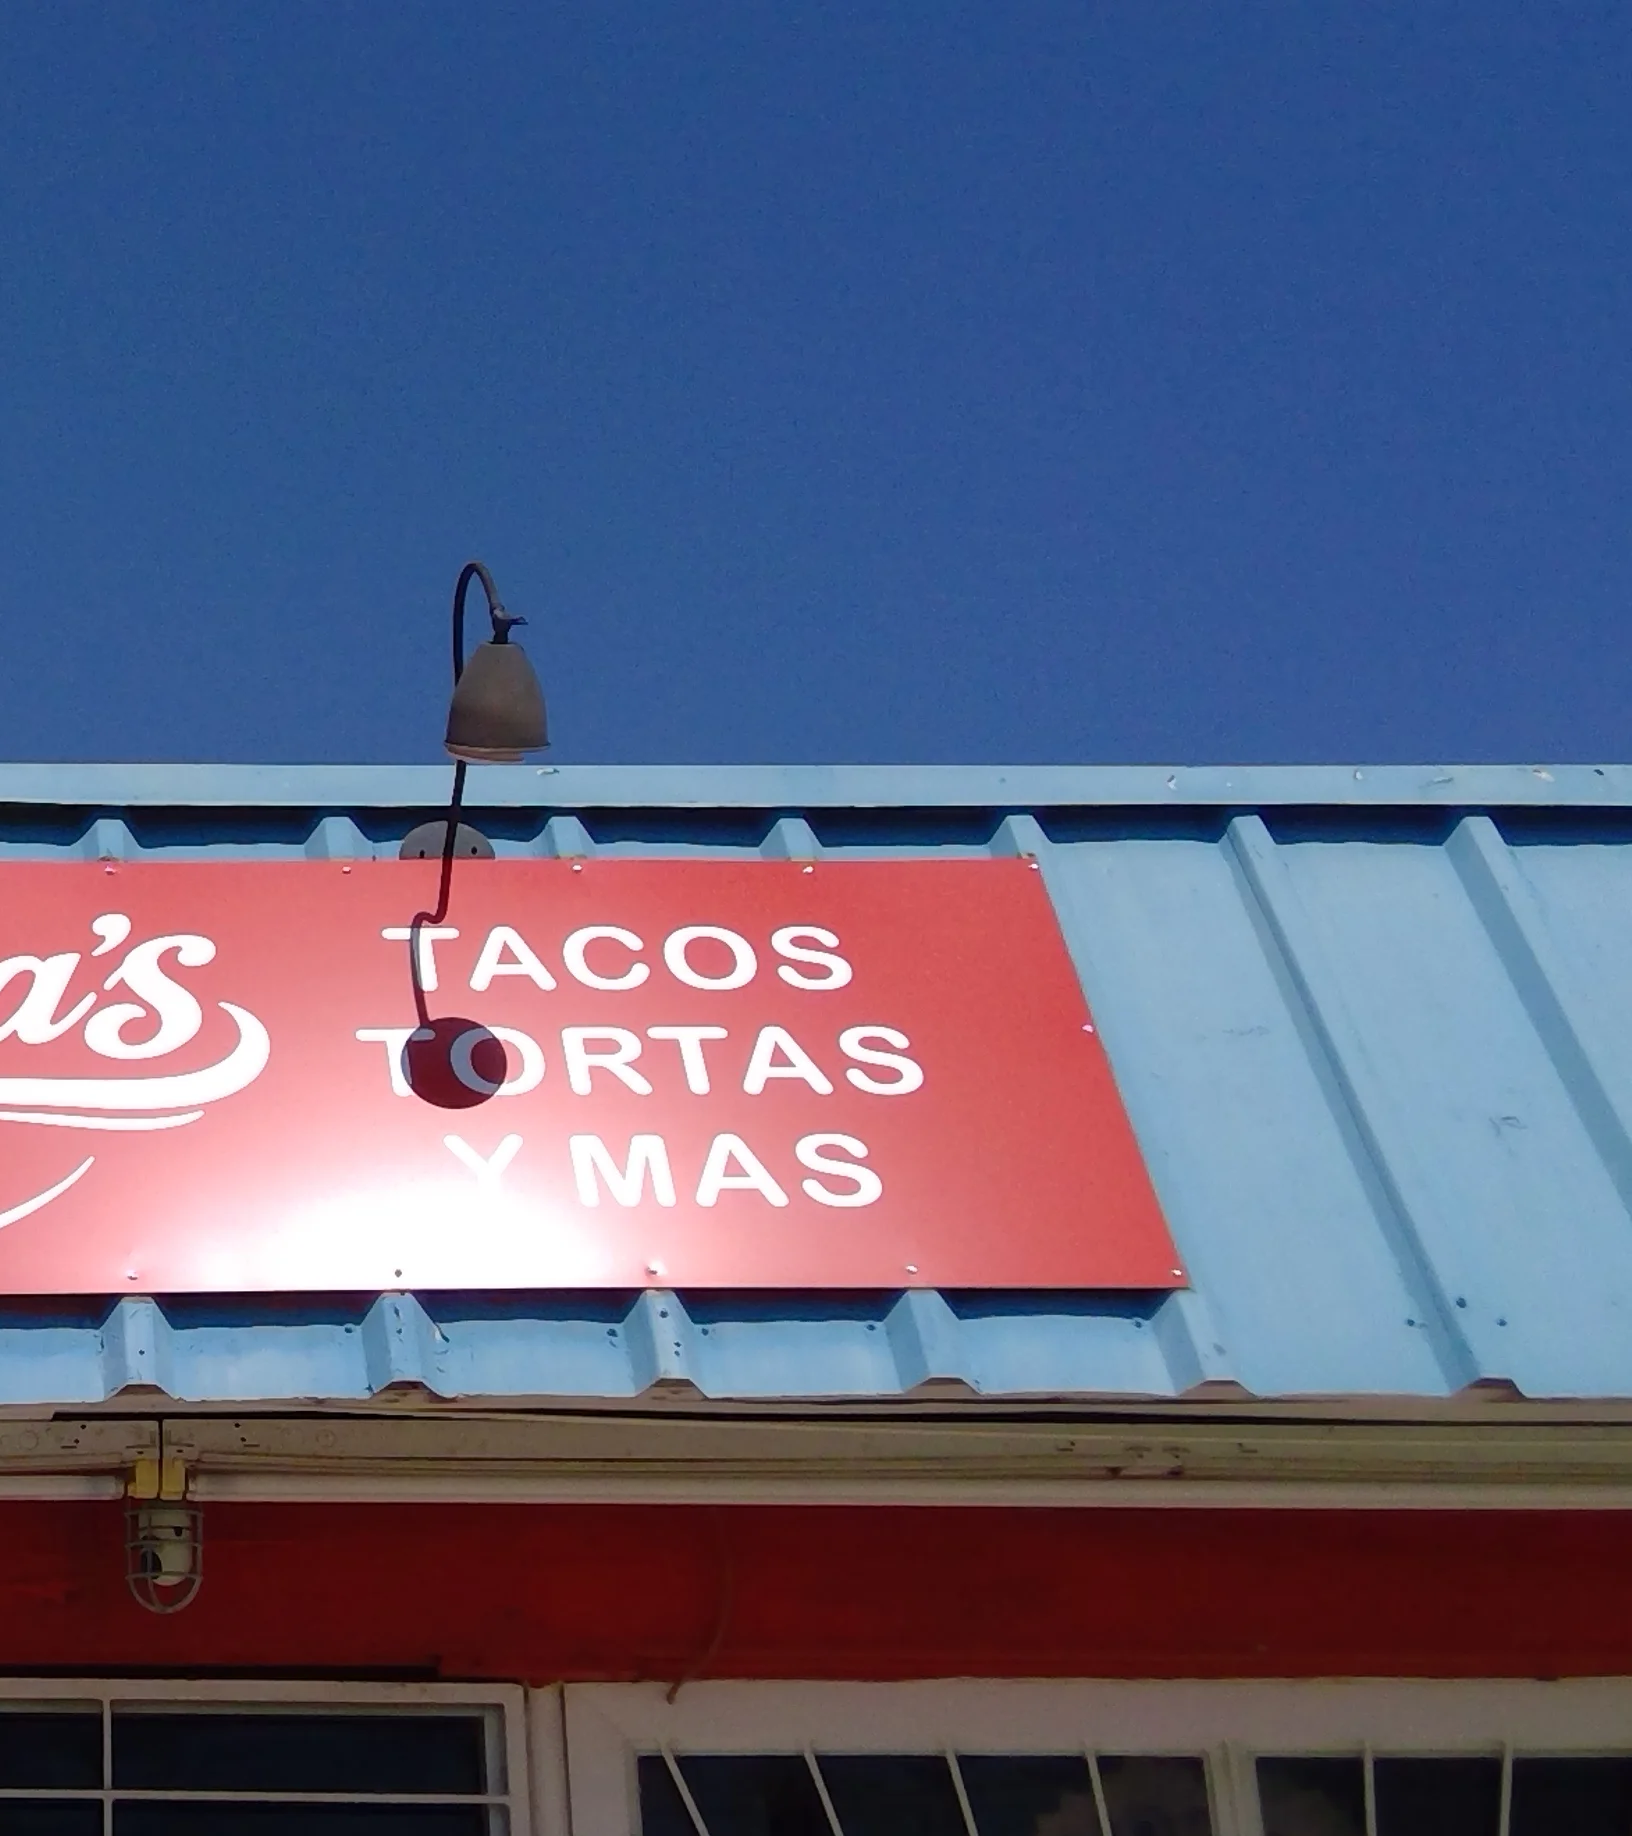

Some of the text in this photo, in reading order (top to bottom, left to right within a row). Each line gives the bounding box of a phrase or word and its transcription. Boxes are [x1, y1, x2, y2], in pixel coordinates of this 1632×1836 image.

[381, 926, 854, 992] TACOS
[355, 1026, 925, 1097] TORTAS
[443, 1134, 885, 1208] Y MAS
